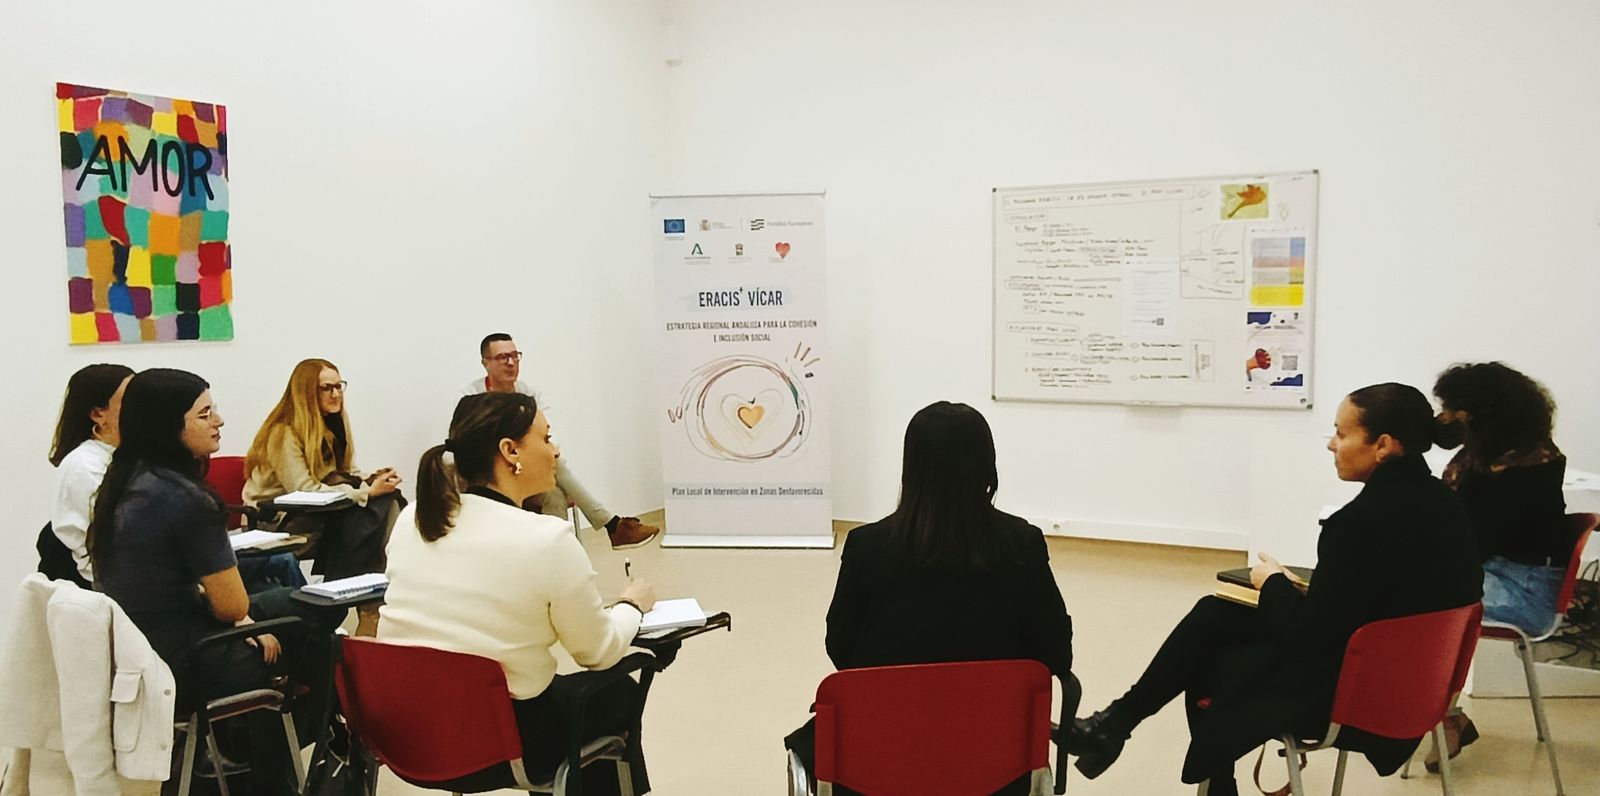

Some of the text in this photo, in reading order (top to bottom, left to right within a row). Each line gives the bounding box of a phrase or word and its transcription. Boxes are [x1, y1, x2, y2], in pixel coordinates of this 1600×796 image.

[76, 134, 214, 201] AMOR
[748, 287, 783, 306] VÍCAR
[666, 319, 817, 331] ESTRATEGIA REGIONAL ANDALUZA PARA LA COHESIÓN
[718, 333, 749, 342] INCLUSIÓN
[751, 333, 771, 341] SOCIAL
[672, 487, 685, 496] Plan
[686, 487, 702, 496] Local
[704, 487, 712, 495] de
[713, 487, 749, 496] Intervención
[759, 487, 777, 495] Zonas
[778, 487, 823, 496] Desfavorecidas
